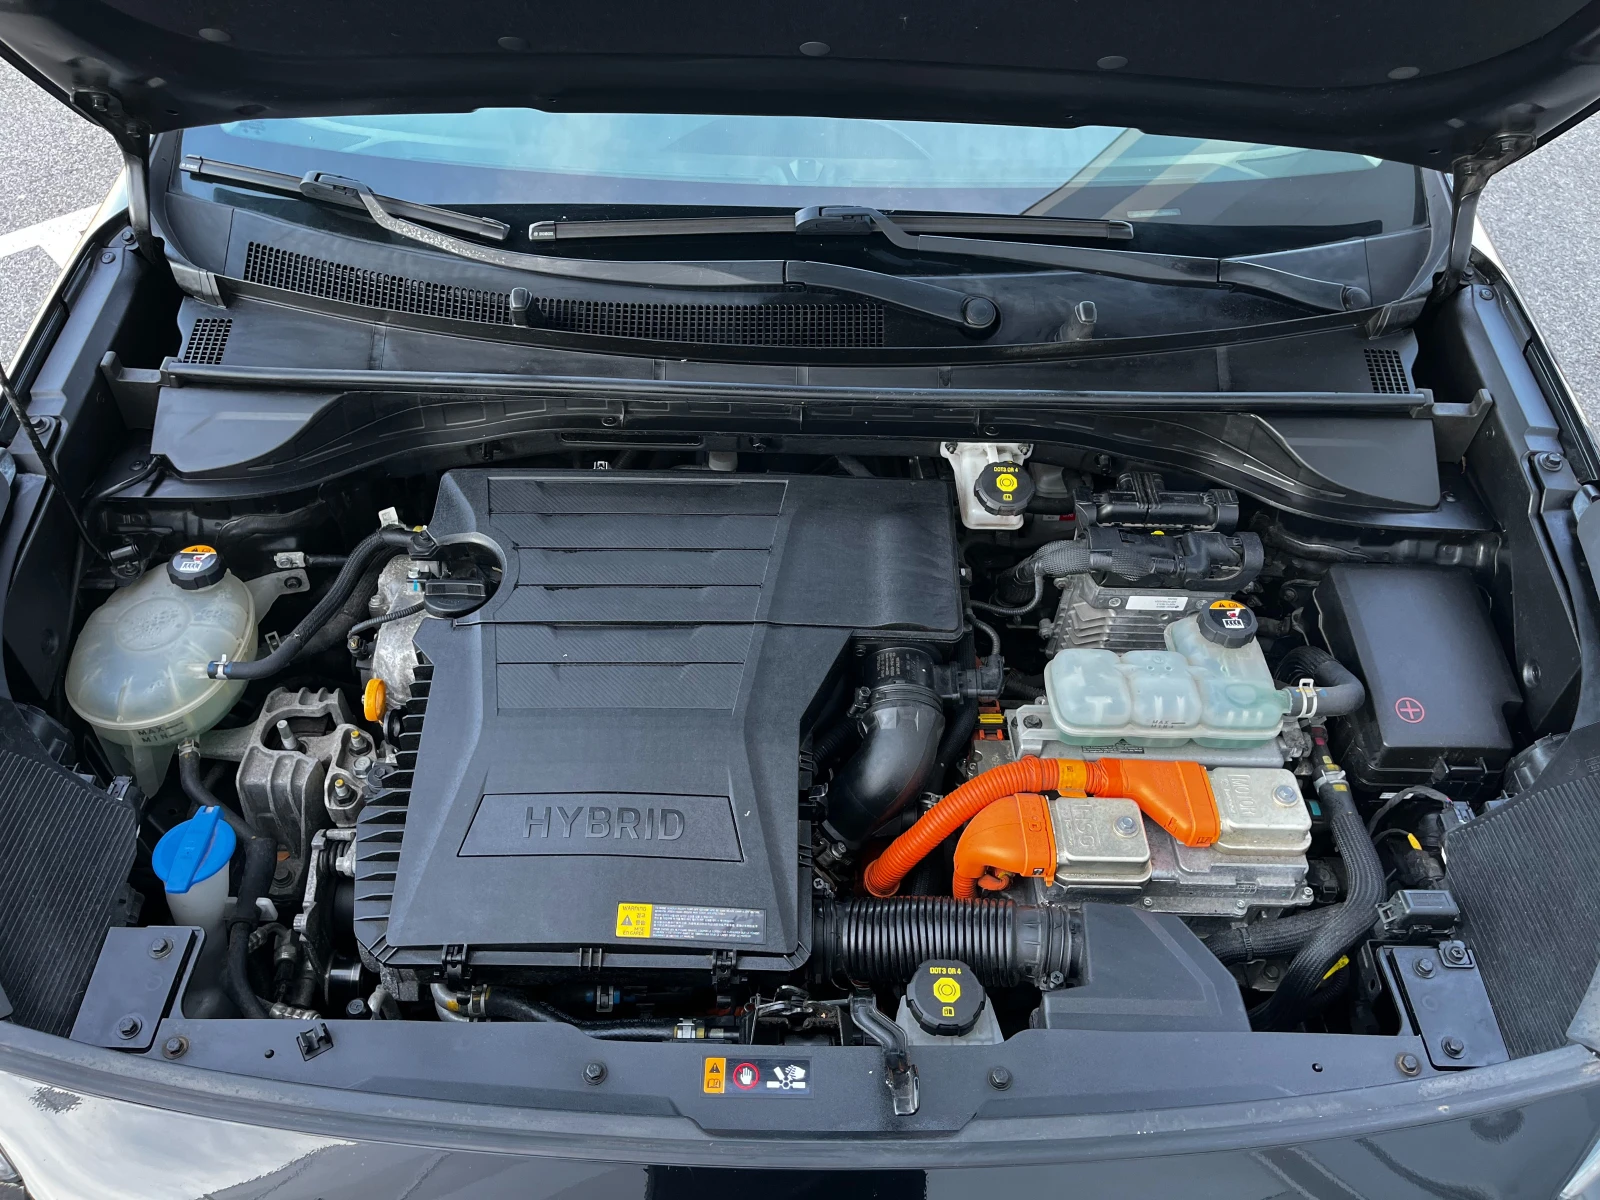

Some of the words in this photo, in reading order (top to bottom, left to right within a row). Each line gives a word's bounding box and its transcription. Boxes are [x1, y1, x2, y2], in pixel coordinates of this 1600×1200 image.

[138, 725, 164, 736] MAX
[142, 733, 168, 743] MIN
[522, 806, 685, 841] HYBRID
